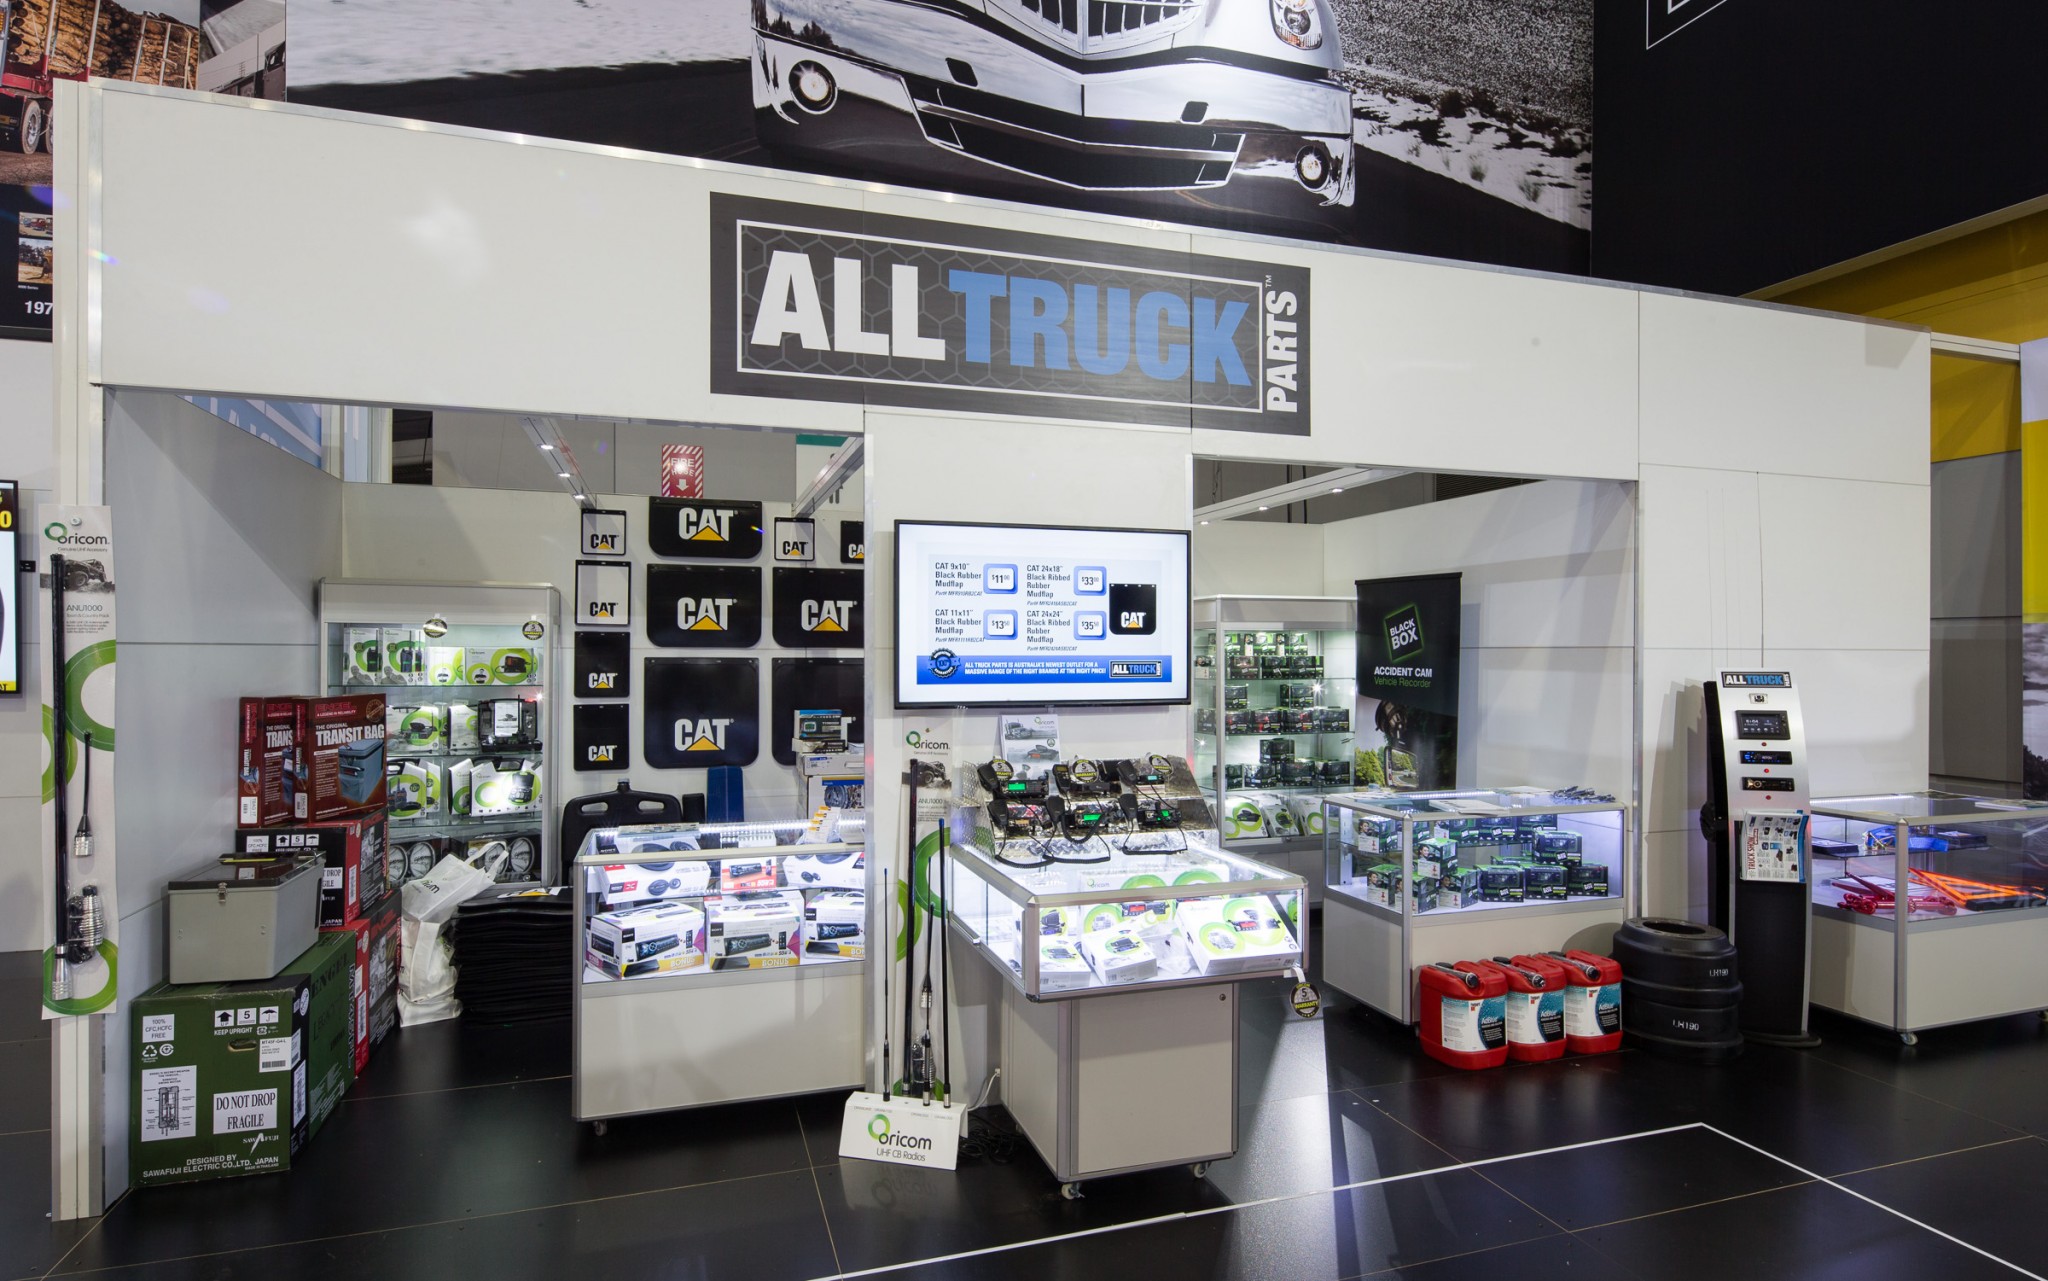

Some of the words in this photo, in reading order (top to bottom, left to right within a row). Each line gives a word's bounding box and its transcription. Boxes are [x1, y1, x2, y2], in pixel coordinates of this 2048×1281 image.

[1265, 290, 1297, 412] PARTS
[671, 458, 694, 467] FIRE
[678, 507, 734, 541] CAT
[590, 534, 617, 550] CAT
[782, 540, 805, 556] CAT
[848, 543, 864, 558] CA
[935, 562, 949, 570] CAT
[935, 571, 955, 579] Black
[935, 580, 963, 589] Mudflap
[1027, 590, 1053, 599] Mudflap
[66, 604, 103, 612] ANU1000
[589, 602, 616, 617] CAT
[677, 597, 733, 630] CAT
[801, 599, 853, 632] CAT
[1121, 612, 1145, 628] CAT
[1390, 618, 1415, 637] BLACK
[935, 627, 963, 635] Mudflap
[1391, 627, 1418, 650] BOX
[1027, 636, 1053, 644] Mudflap
[1374, 666, 1413, 677] ACCIDENT
[1415, 668, 1432, 677] CAM
[588, 672, 616, 689] CAT
[1374, 677, 1397, 685] Vehicle
[1399, 677, 1431, 688] Recorder
[266, 730, 293, 748] TRANS
[316, 726, 363, 746] TRANSIT
[364, 724, 385, 739] BAG
[674, 718, 729, 751] CAT
[588, 745, 615, 762] CAT
[327, 869, 341, 877] DROP
[762, 958, 789, 967] BONUS
[1301, 988, 1307, 997] 5
[1294, 1001, 1318, 1009] WARRANTY
[243, 1010, 250, 1019] 5
[216, 1097, 229, 1110] DO
[230, 1095, 249, 1109] NOT
[251, 1092, 276, 1107] DROP
[227, 1113, 264, 1129] FRAGILE
[186, 1156, 225, 1166] DESIGNED
[876, 1147, 891, 1157] UHF
[892, 1149, 901, 1159] CB
[903, 1150, 926, 1161] Radios
[143, 1167, 181, 1178] SAWAFUJI
[183, 1163, 220, 1173] ELECTRIC
[254, 1156, 279, 1165] JAPAN
